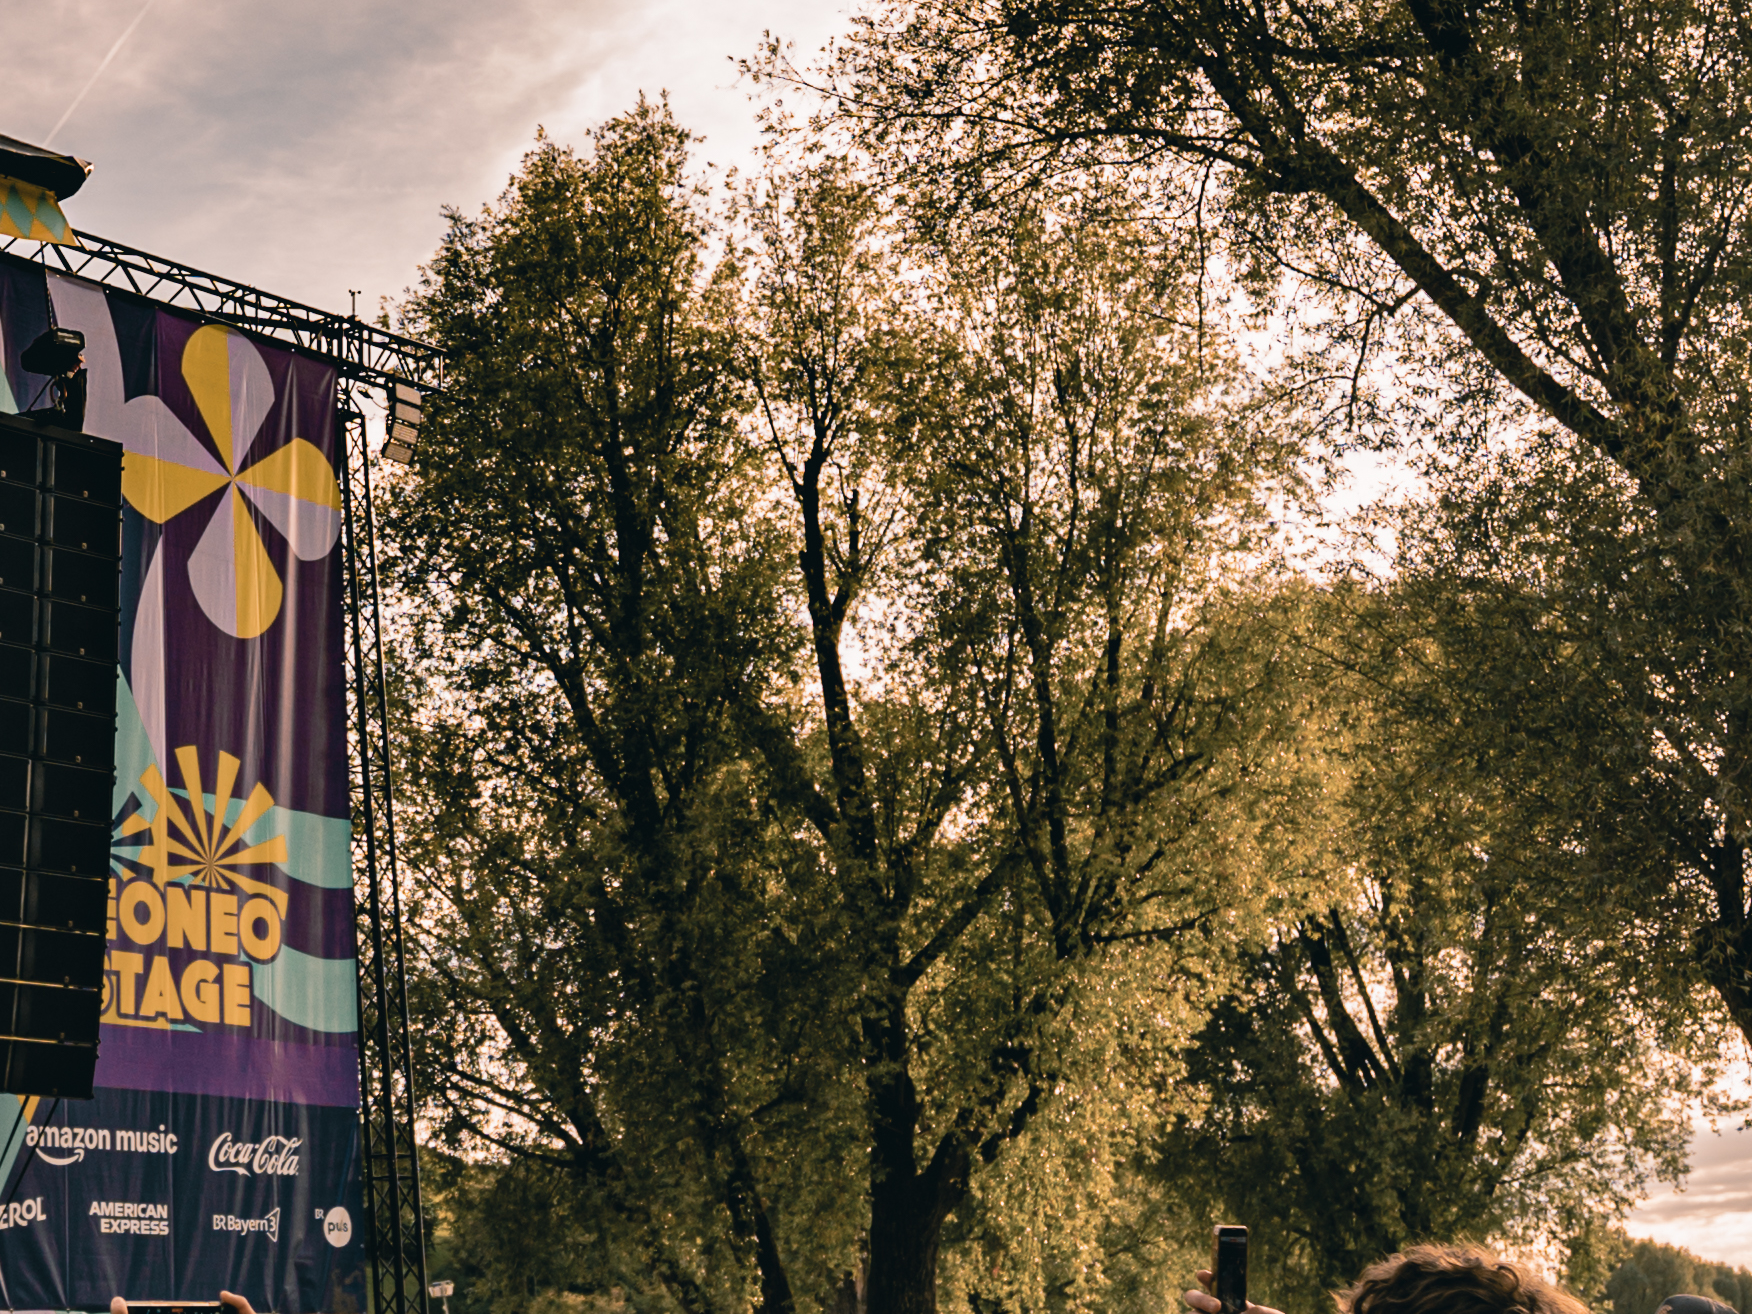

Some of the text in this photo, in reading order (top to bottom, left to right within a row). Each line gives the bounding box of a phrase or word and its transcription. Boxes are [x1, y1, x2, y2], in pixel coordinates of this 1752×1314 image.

[106, 878, 281, 960] ONEO
[101, 950, 251, 1026] TAGE
[26, 1124, 178, 1155] amazon music
[208, 1132, 303, 1177] Coca-Cola
[89, 1201, 168, 1219] AMERICAN
[100, 1218, 169, 1235] EXPRESS
